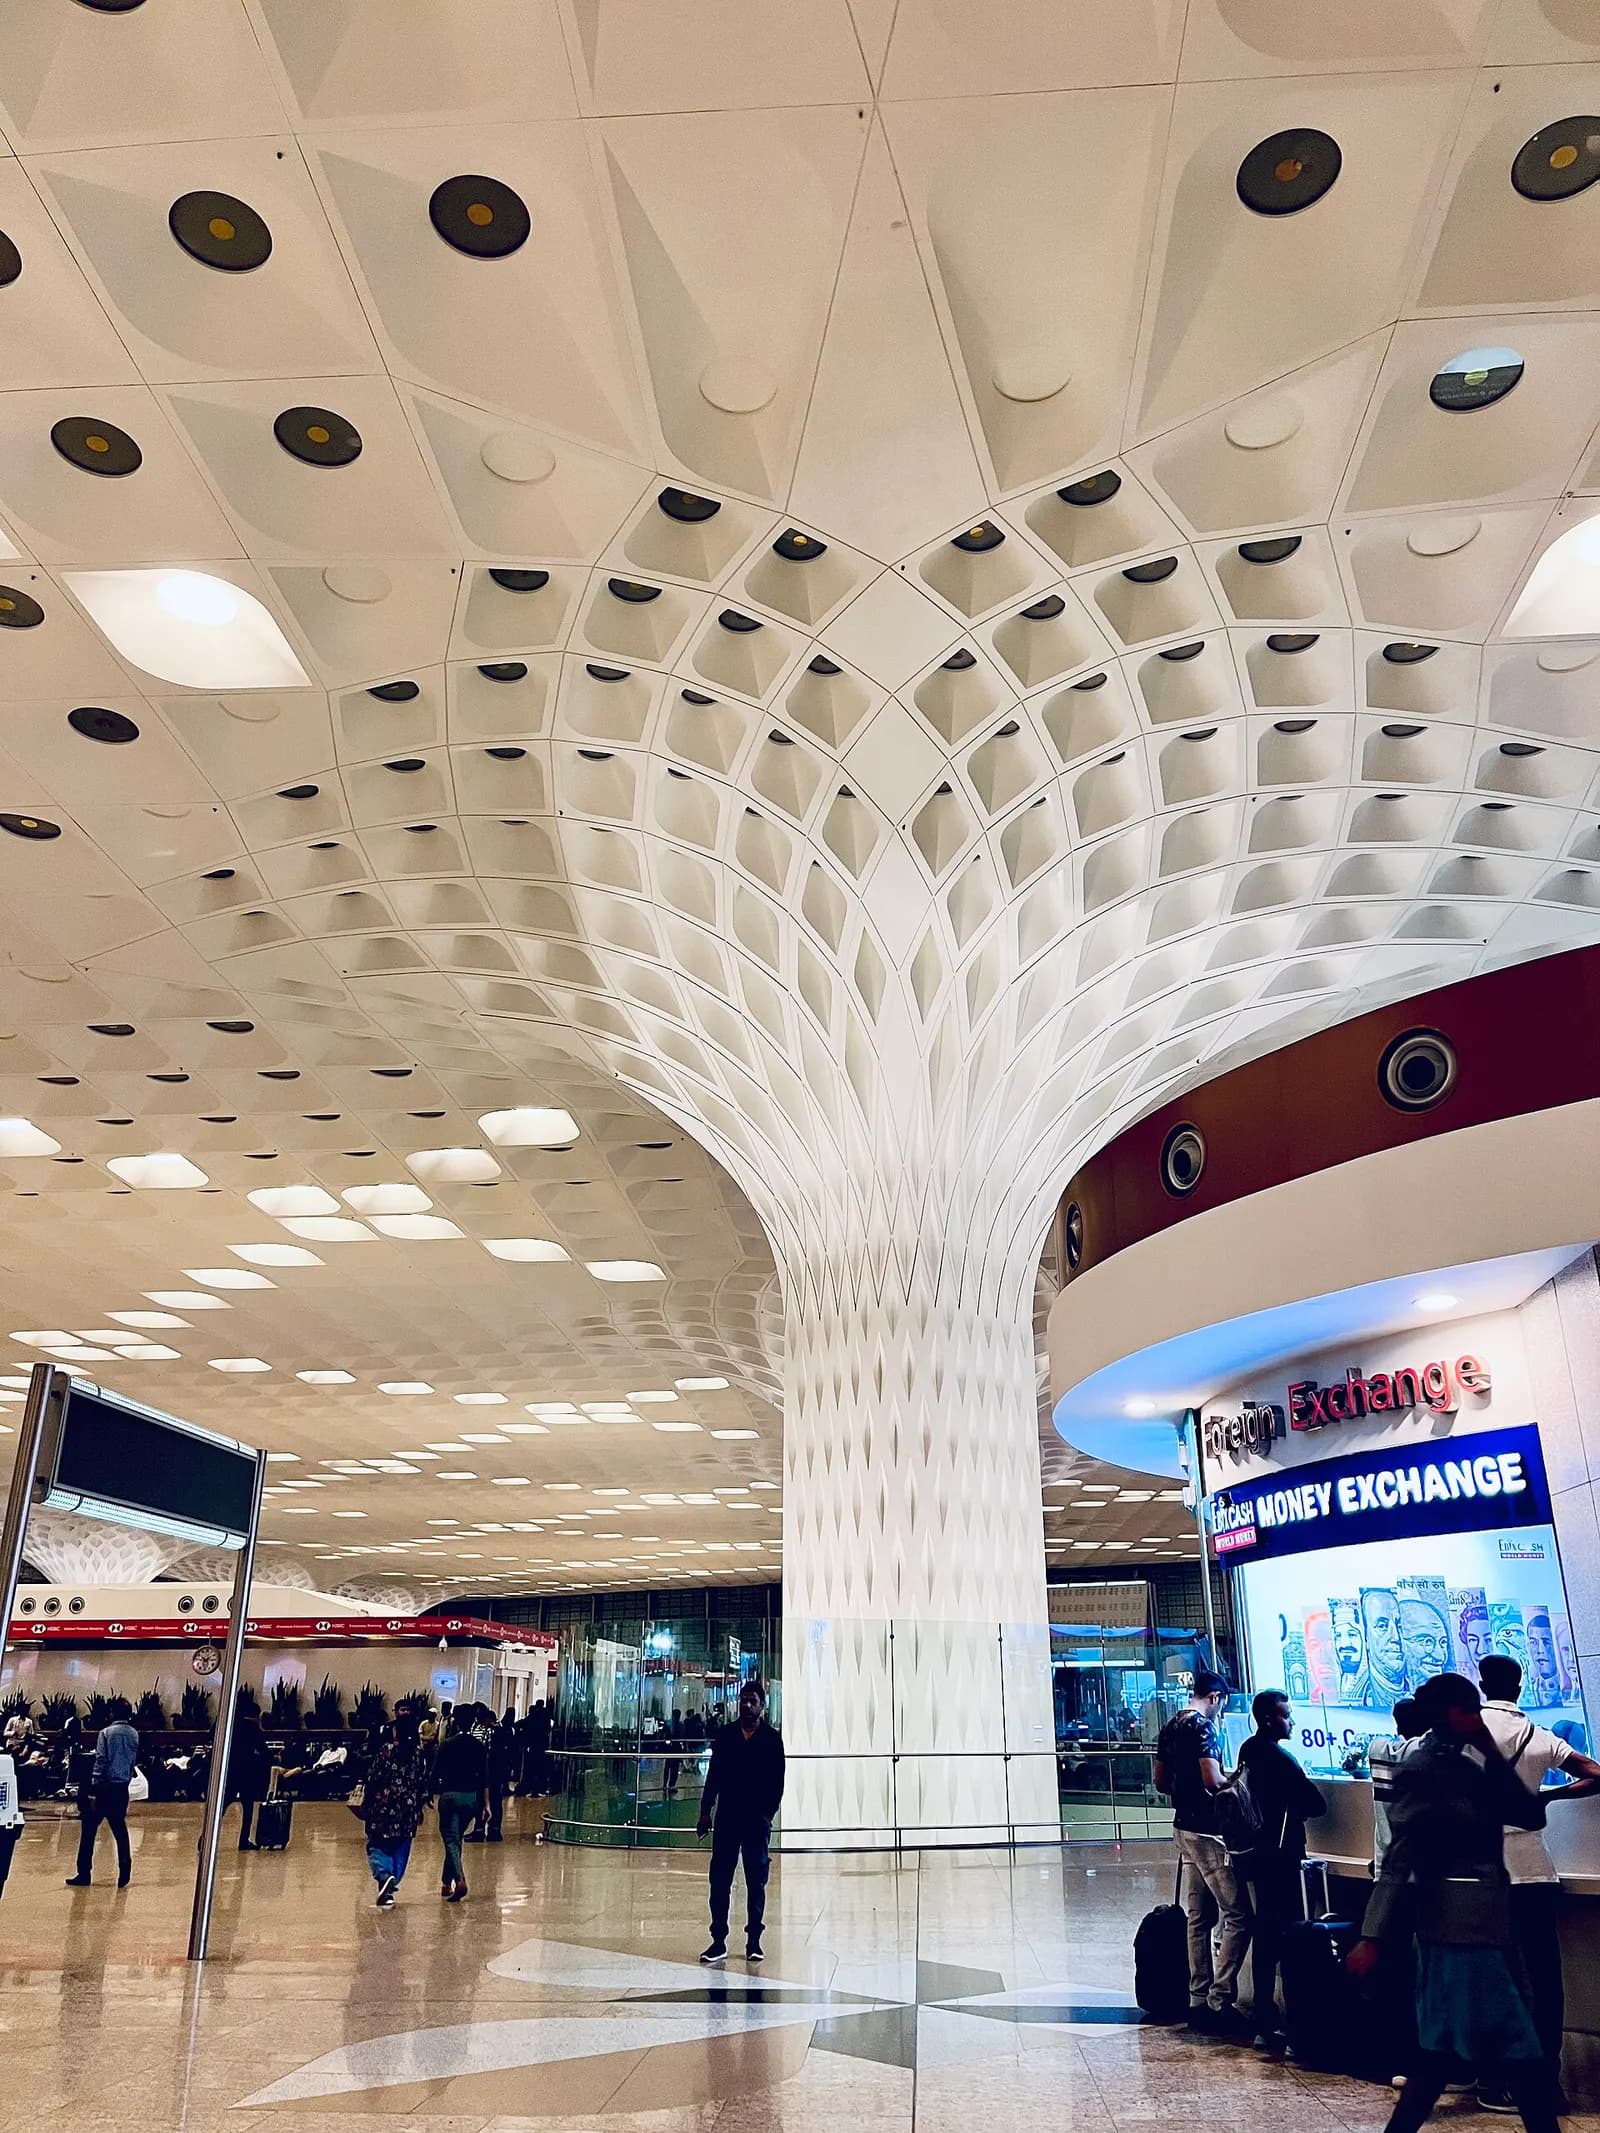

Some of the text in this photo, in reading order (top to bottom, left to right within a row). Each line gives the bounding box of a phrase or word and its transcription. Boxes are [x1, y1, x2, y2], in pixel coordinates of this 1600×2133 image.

[1204, 1355, 1486, 1456] Foreign Exchange
[1257, 1452, 1527, 1528] MONEY EXCHANGE
[1301, 1728, 1337, 1748] 80+
